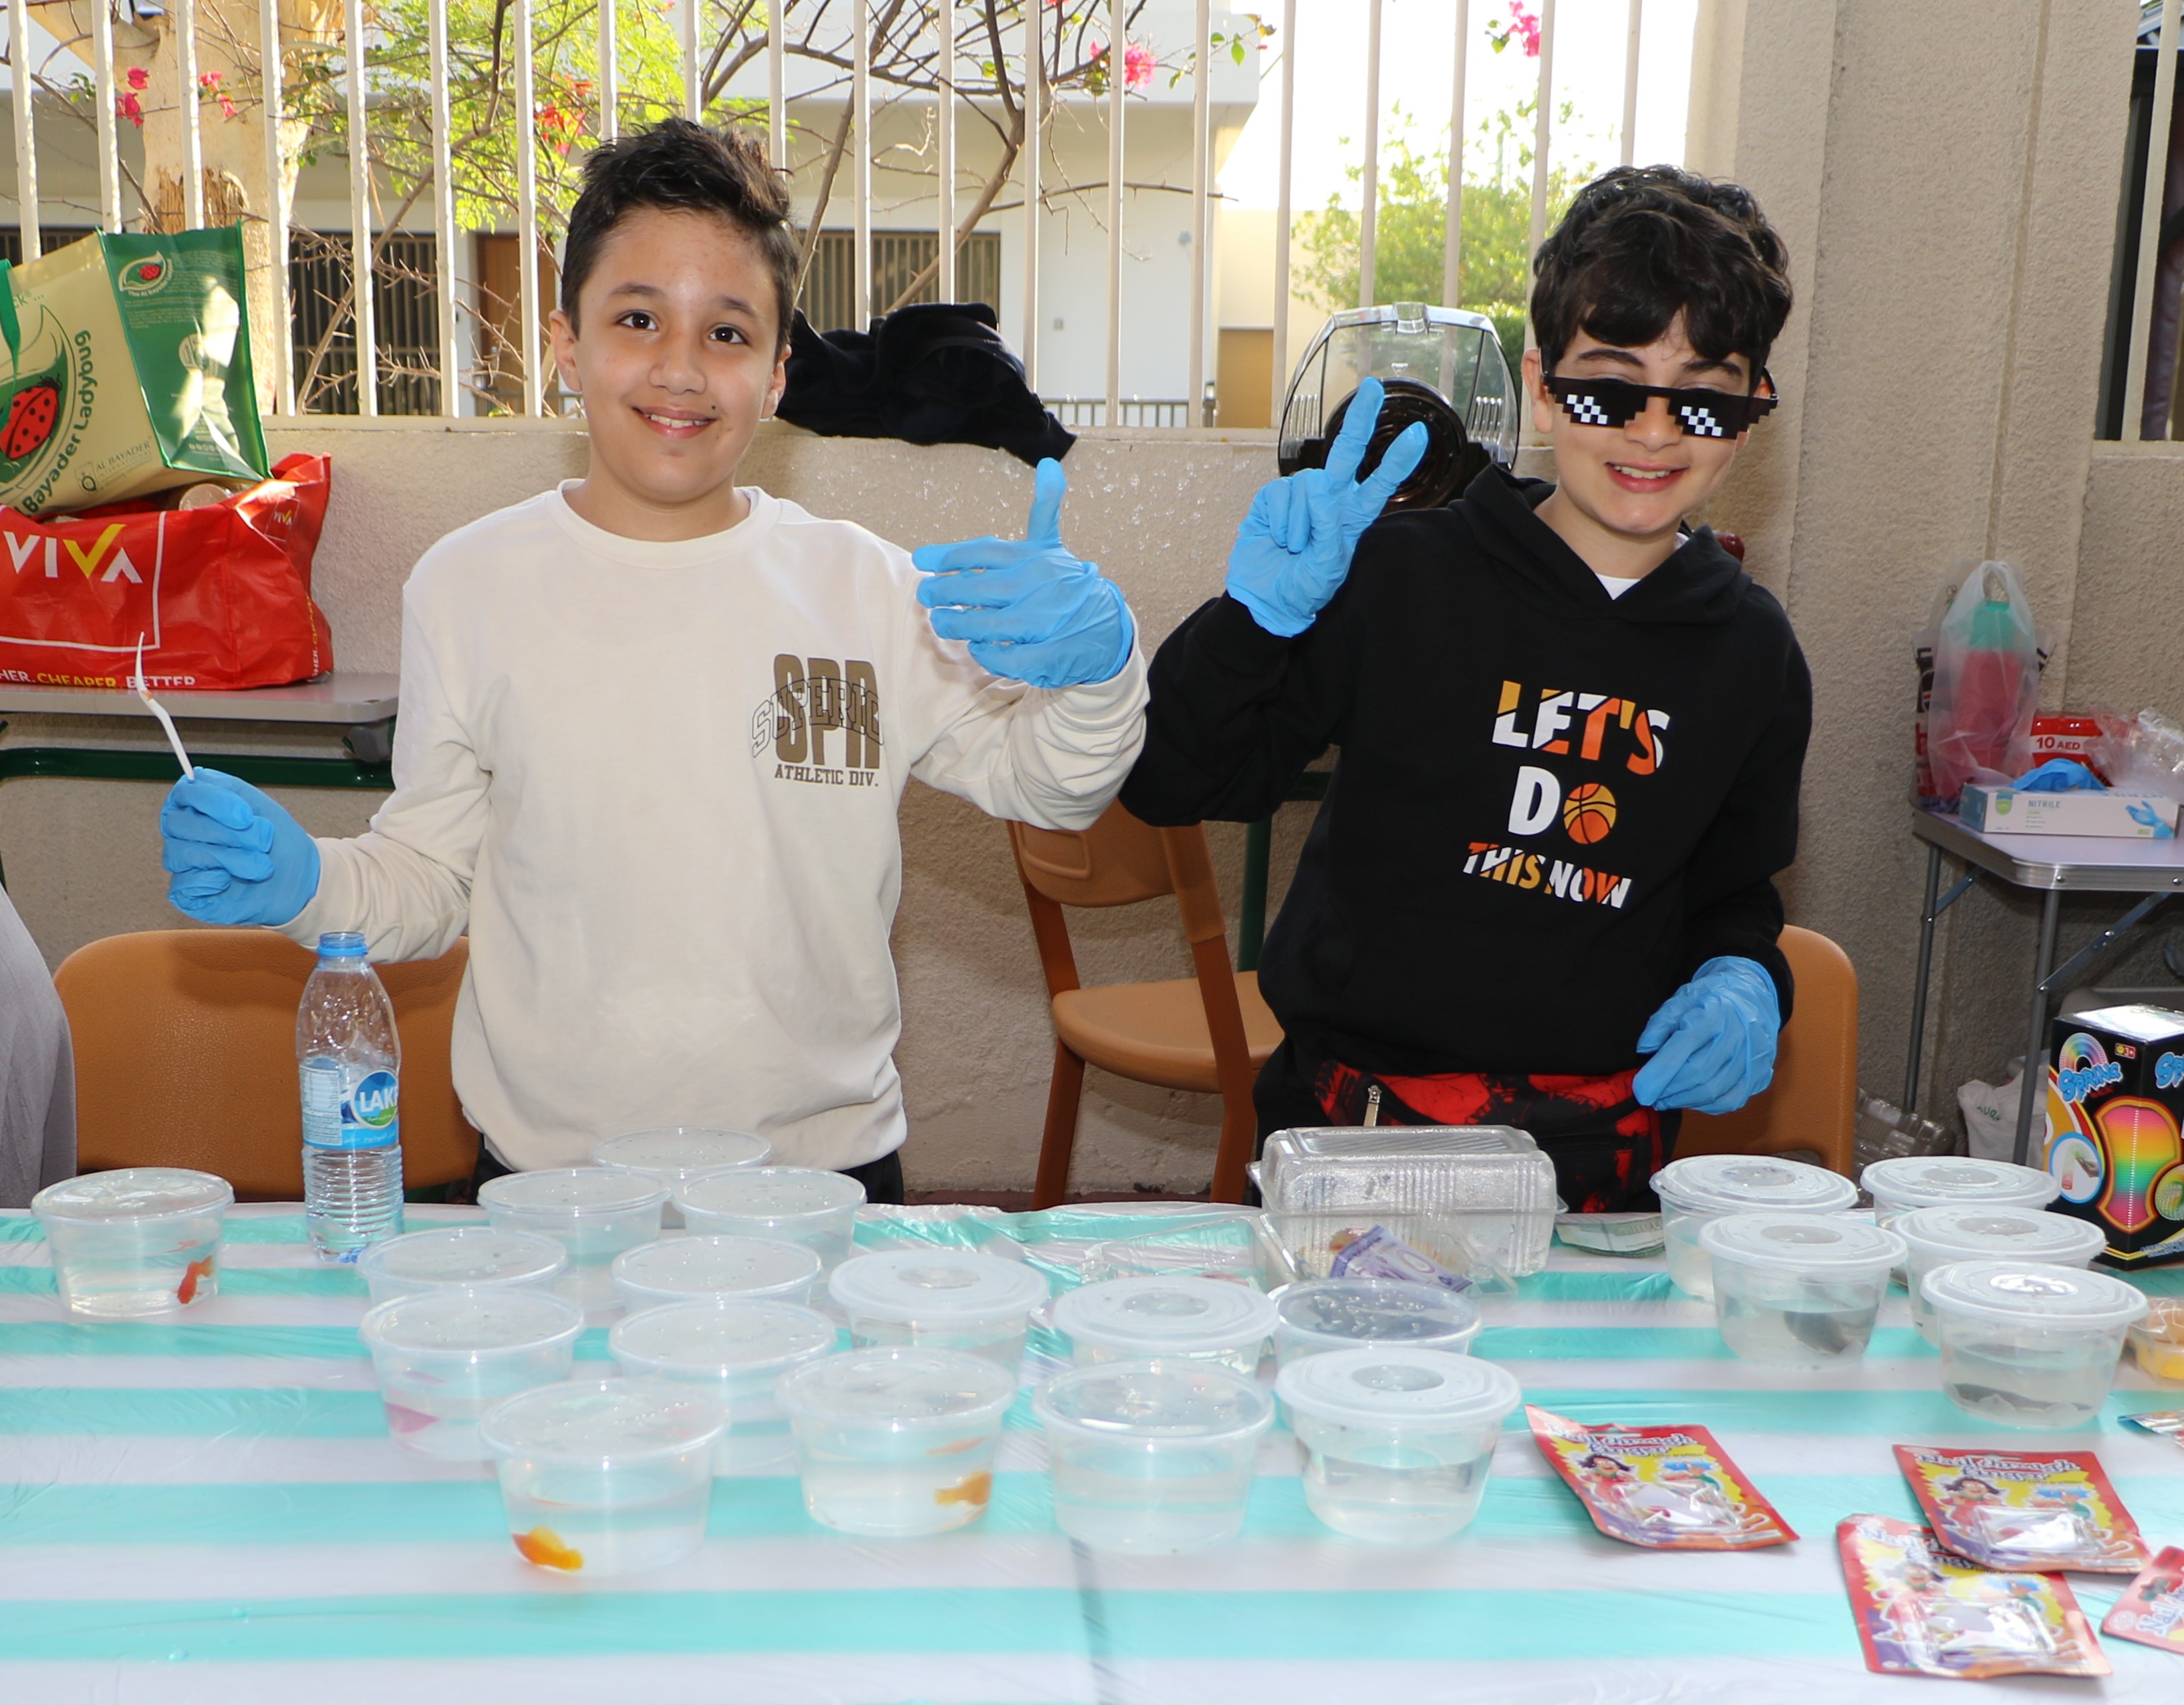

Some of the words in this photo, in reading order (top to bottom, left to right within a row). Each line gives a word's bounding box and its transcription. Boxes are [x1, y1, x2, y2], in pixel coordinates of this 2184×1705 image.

[21, 433, 82, 513] Bayader
[74, 329, 98, 430] Ladybug
[108, 440, 150, 465] BAYADER
[3, 524, 143, 583] VIVA
[37, 672, 118, 688] CHEAPER
[773, 653, 880, 770] SPR
[1492, 680, 1670, 776] LET'S
[2036, 736, 2055, 749] 10
[2057, 741, 2081, 750] AED
[774, 764, 844, 785] ATHLETIC
[848, 770, 879, 787] DIV.
[2028, 800, 2061, 809] NITRILE
[1462, 841, 1546, 890] THIS
[1544, 859, 1632, 909] NOW
[2124, 1046, 2135, 1057] 3+
[2057, 1062, 2123, 1103] SPRING
[1546, 1423, 1599, 1445] Nail
[1600, 1432, 1697, 1447] through
[1588, 1442, 1671, 1457] finger
[1915, 1453, 1975, 1468] Nail
[1977, 1457, 2081, 1474] through
[1959, 1466, 2050, 1482] finger
